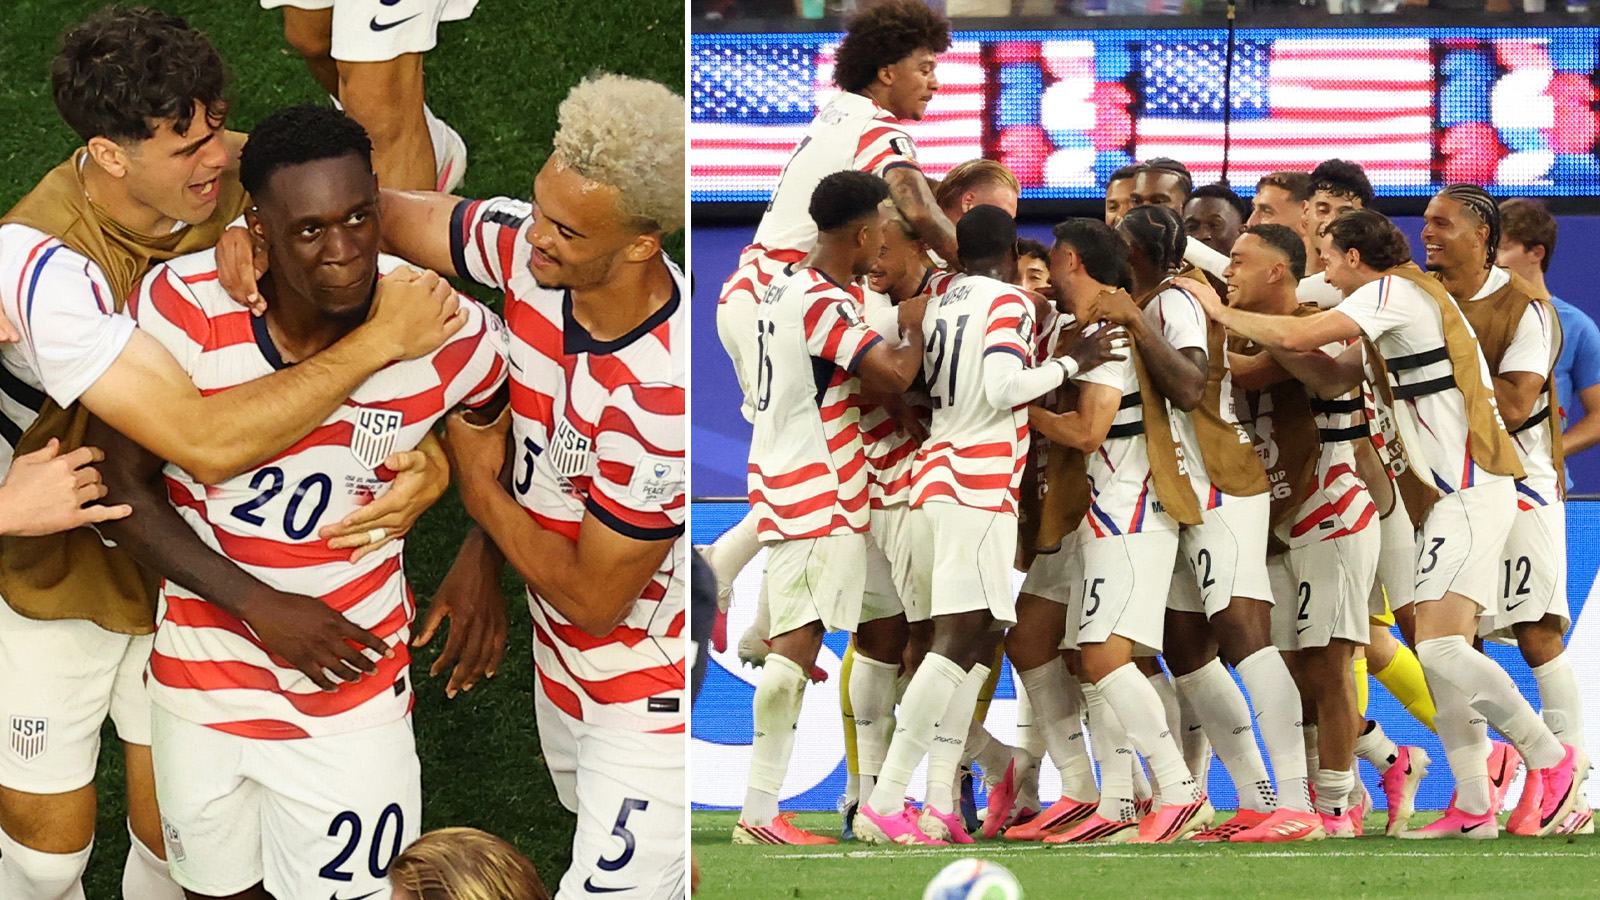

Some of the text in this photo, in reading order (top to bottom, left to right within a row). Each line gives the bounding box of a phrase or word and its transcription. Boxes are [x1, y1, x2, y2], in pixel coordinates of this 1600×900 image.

[926, 314, 970, 410] 21
[360, 411, 398, 435] USA
[557, 420, 588, 451] USA
[515, 436, 544, 496] 5
[1267, 470, 1286, 483] UP
[230, 466, 332, 540] 20
[1190, 548, 1216, 590] 2
[1417, 537, 1446, 576] 3
[1081, 578, 1106, 617] 15
[1503, 556, 1532, 599] 12
[1298, 581, 1311, 620] 2
[13, 718, 45, 737] USA
[318, 802, 404, 882] 20
[596, 797, 650, 872] 5
